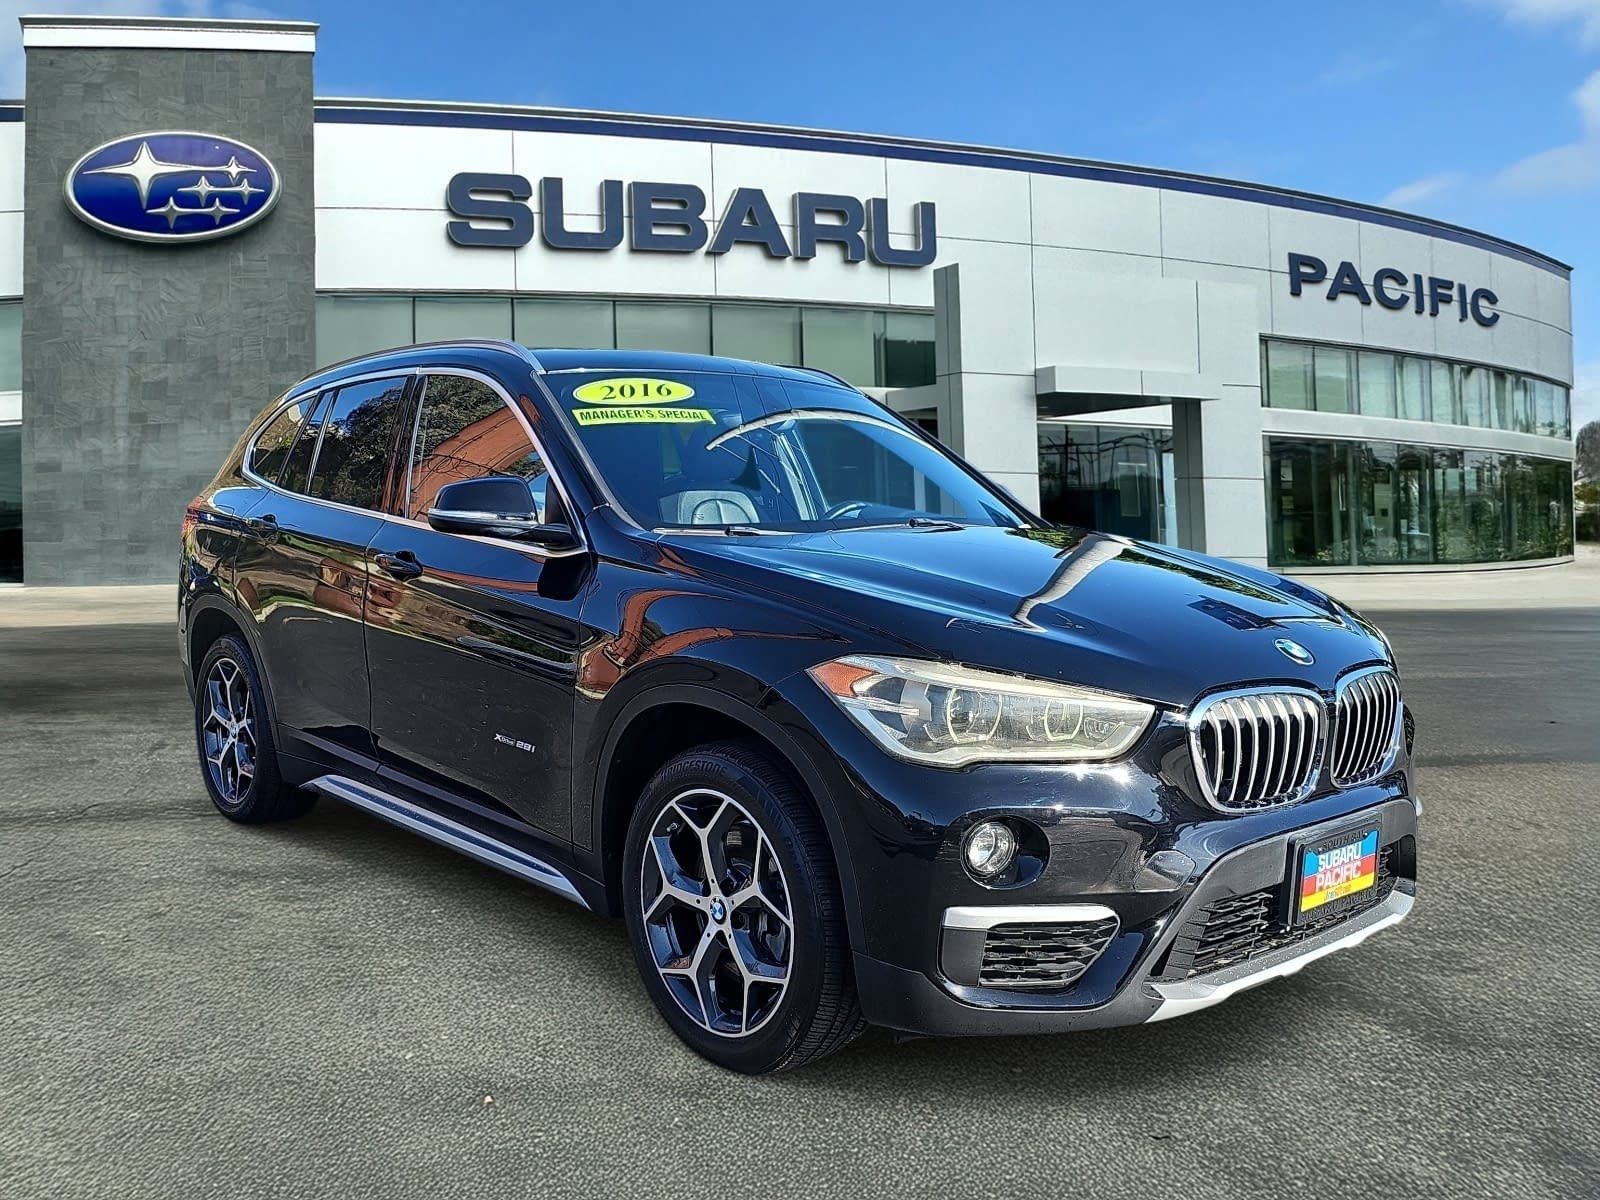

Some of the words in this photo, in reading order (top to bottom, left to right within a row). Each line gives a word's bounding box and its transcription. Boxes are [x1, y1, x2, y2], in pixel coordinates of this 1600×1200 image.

[446, 171, 937, 268] SUBARU
[1288, 252, 1500, 328] PACIFIC
[600, 383, 672, 401] 2016
[579, 409, 655, 421] MANAGER'S
[659, 410, 707, 421] SPECIAL
[1318, 842, 1362, 872] SUBARU
[1315, 861, 1362, 892] PACIFIC
